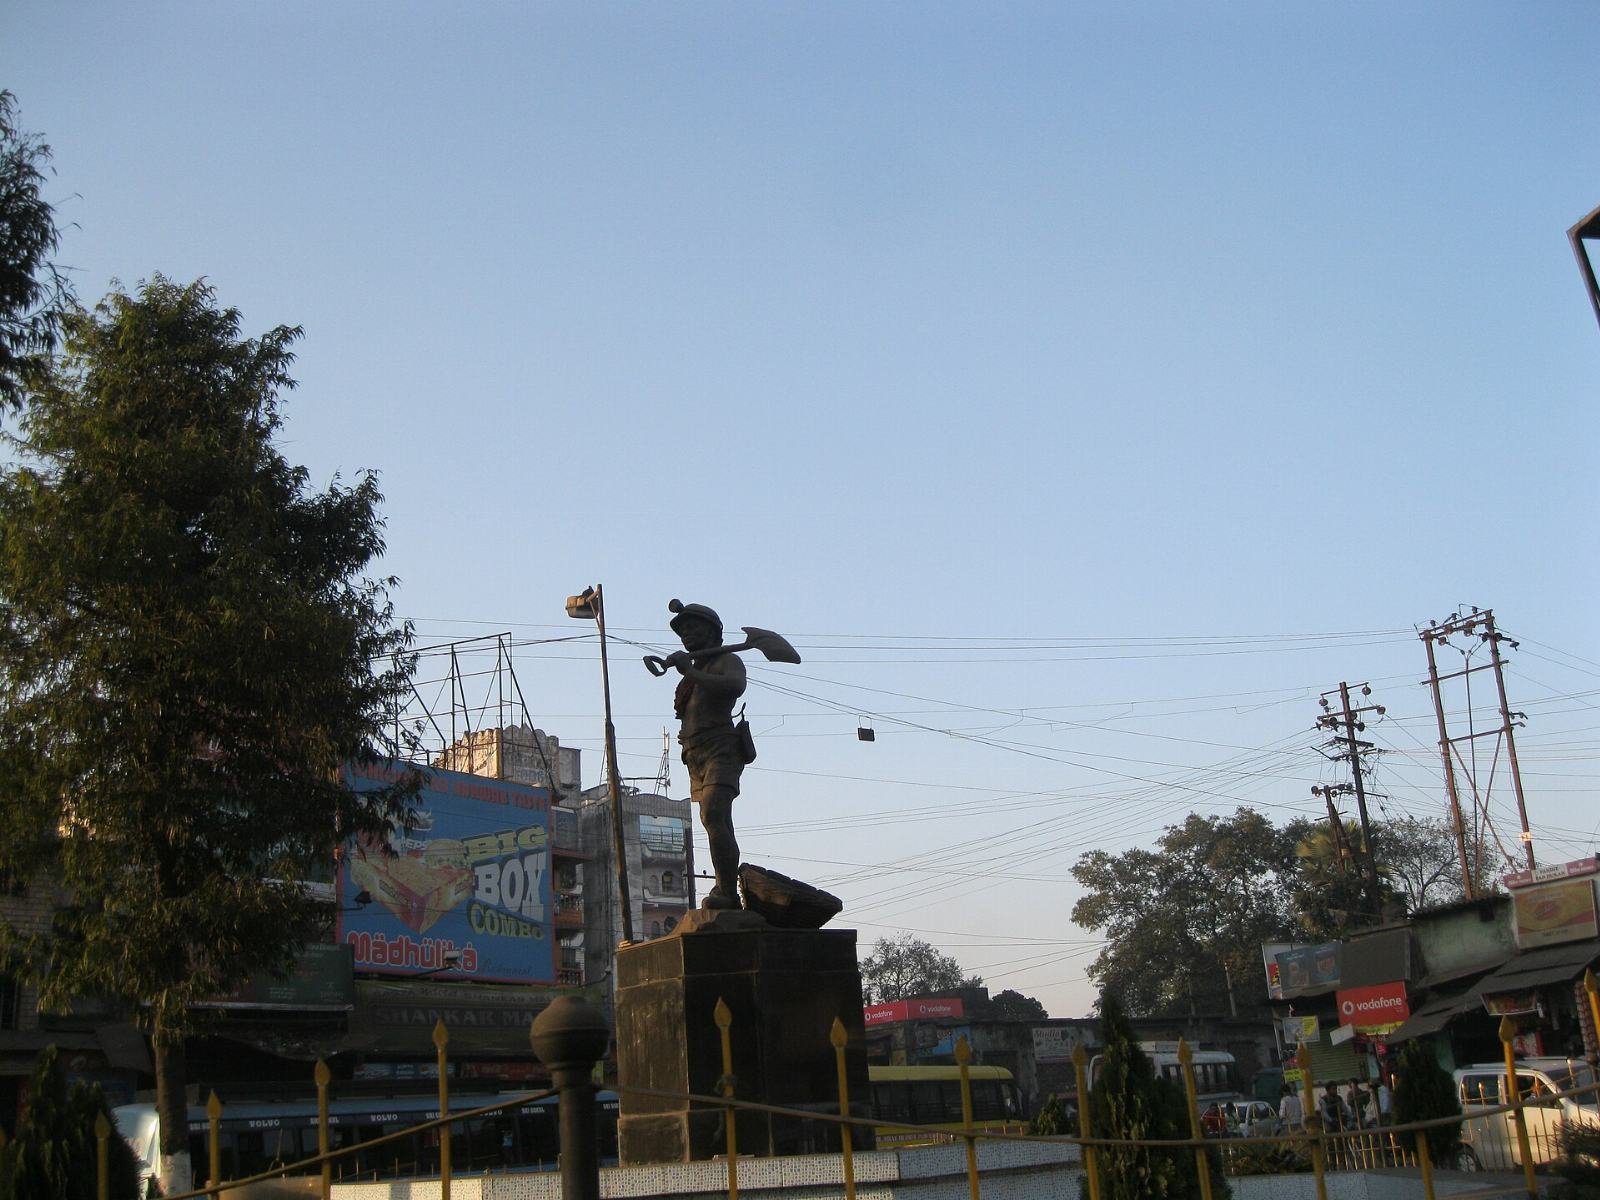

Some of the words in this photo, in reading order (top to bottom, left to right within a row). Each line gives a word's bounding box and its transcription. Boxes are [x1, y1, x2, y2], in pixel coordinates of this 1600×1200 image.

[463, 824, 548, 866] BIG
[473, 851, 548, 923] BOX
[469, 902, 546, 941] COMBO
[1356, 996, 1403, 1011] vodafone
[375, 1006, 497, 1026] SHANKAR
[248, 1118, 280, 1128] VOLVO
[370, 1113, 398, 1122] VOLVO
